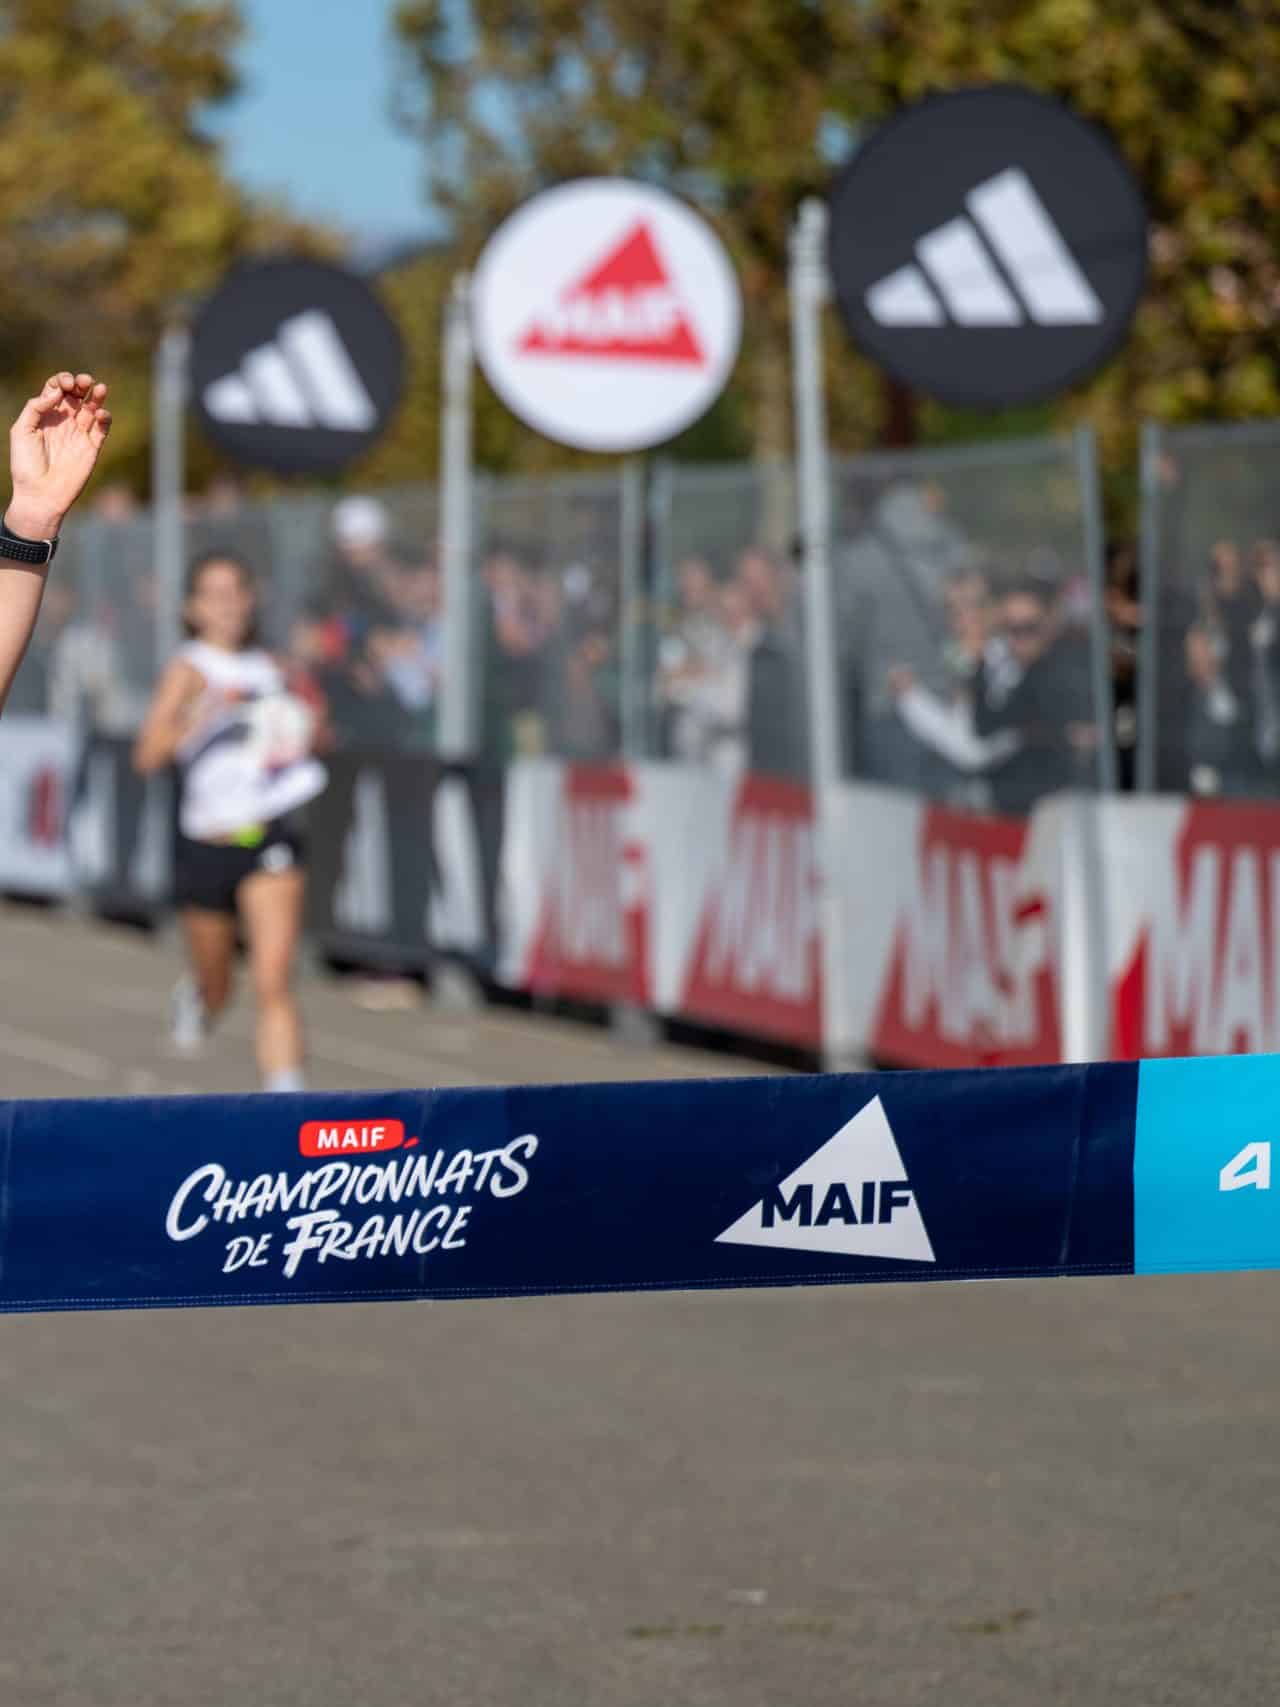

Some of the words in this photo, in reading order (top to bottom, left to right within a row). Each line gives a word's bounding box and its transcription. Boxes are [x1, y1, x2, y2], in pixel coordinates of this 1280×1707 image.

[544, 286, 675, 343] MAIF
[317, 1127, 385, 1149] MAIF
[166, 1134, 538, 1241] CHAMPIONNATS
[761, 1180, 913, 1228] MAIF
[222, 1233, 272, 1273] DE
[282, 1204, 472, 1278] FRANCE
